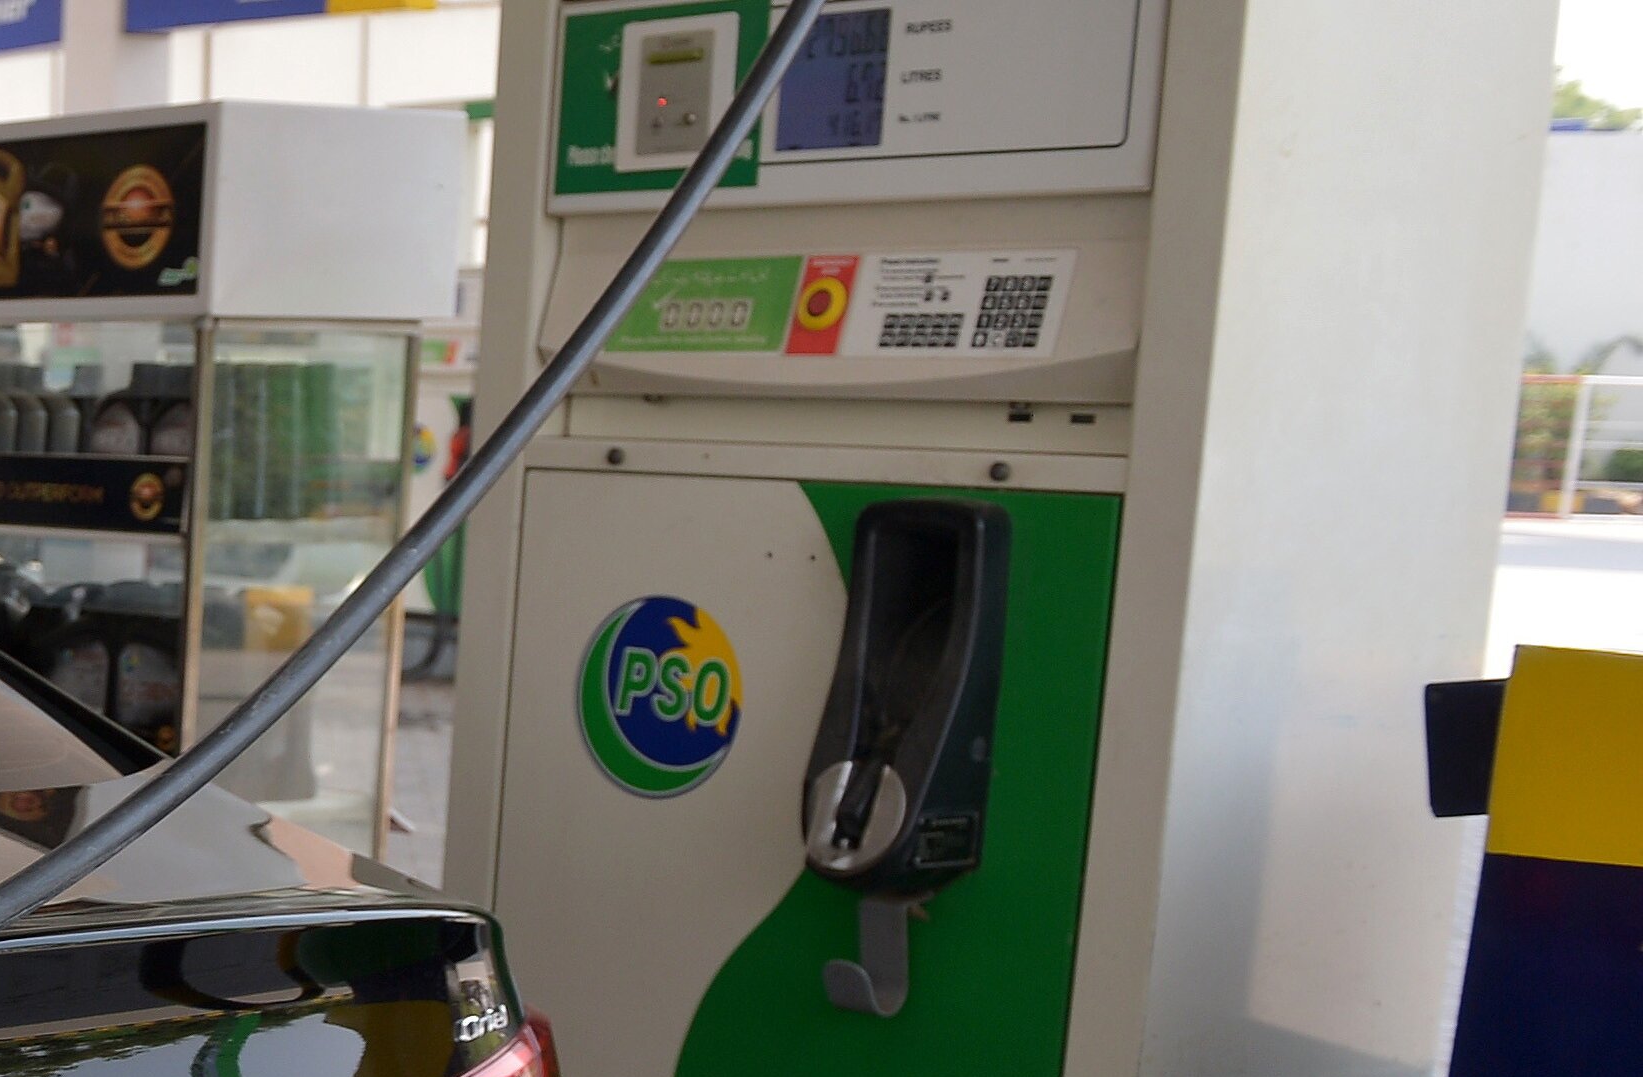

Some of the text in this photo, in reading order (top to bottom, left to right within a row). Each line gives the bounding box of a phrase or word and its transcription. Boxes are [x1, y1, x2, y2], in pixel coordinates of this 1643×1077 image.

[906, 19, 954, 34] RUPEES
[901, 69, 943, 84] LITRES
[615, 646, 732, 728] PSO
